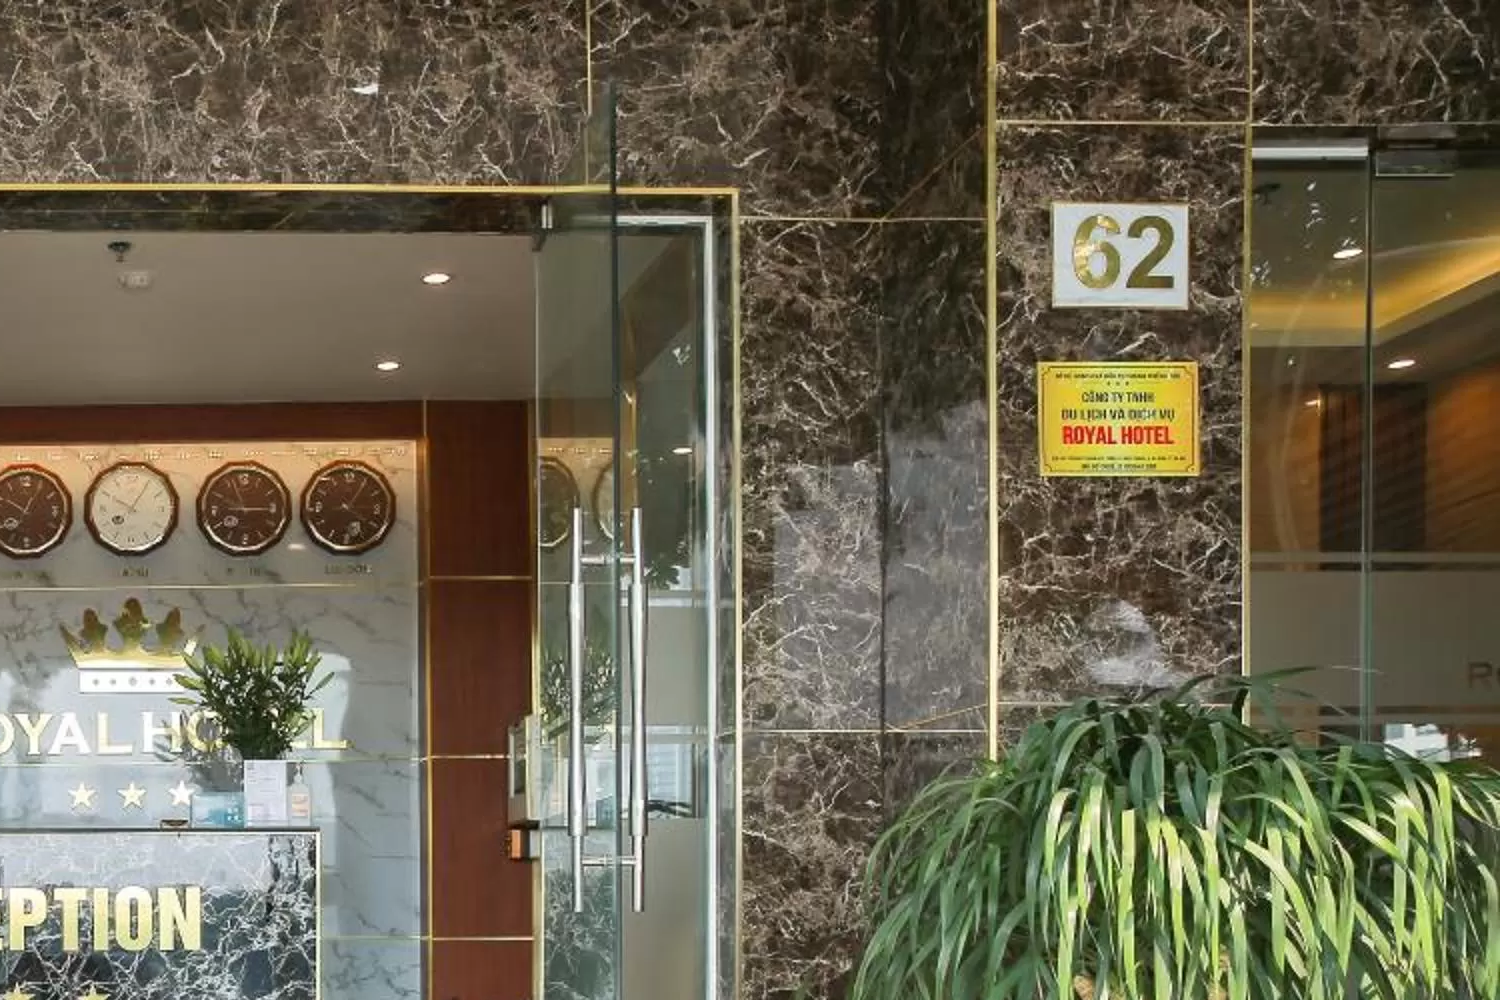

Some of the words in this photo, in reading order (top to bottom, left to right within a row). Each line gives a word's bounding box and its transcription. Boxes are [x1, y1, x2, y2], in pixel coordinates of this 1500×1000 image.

[1072, 213, 1175, 289] 62
[1112, 391, 1125, 403] TY
[1061, 408, 1077, 420] DU
[1062, 425, 1117, 445] ROYAL
[1120, 425, 1175, 445] HOTEL
[141, 707, 352, 754] HOL
